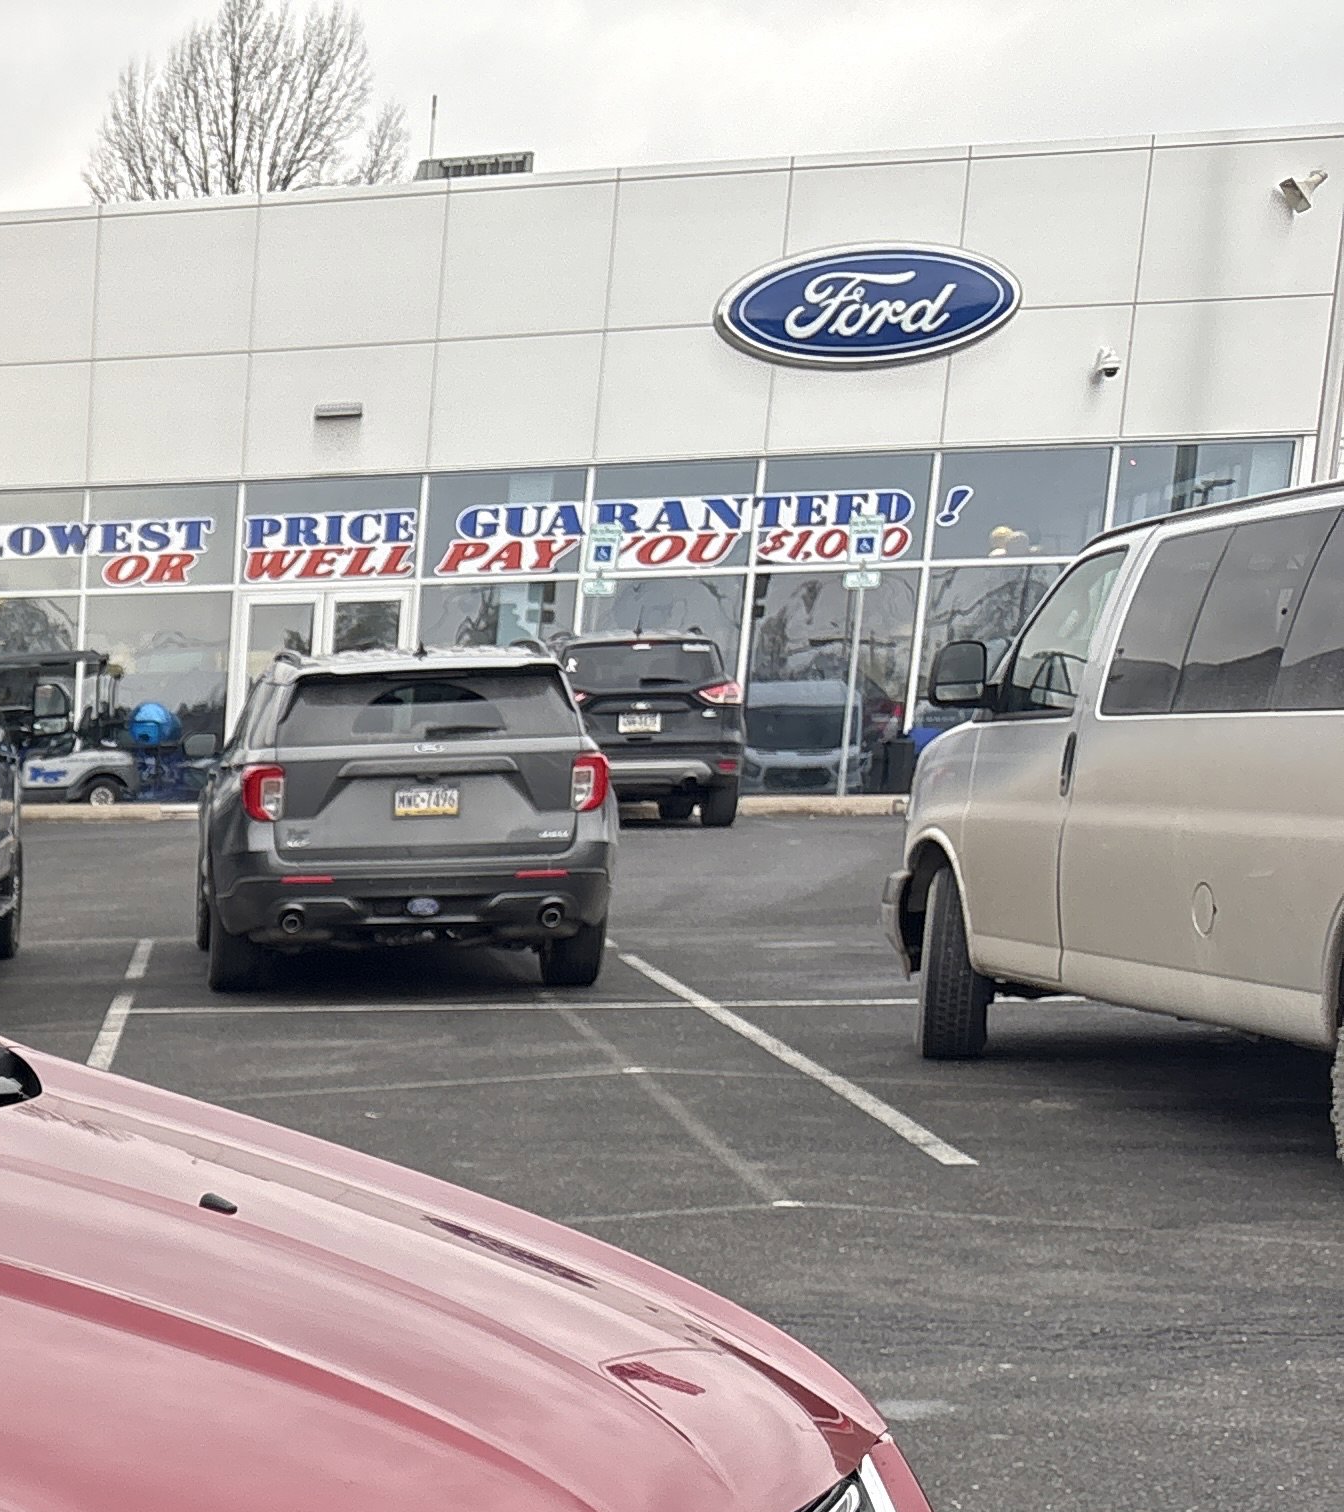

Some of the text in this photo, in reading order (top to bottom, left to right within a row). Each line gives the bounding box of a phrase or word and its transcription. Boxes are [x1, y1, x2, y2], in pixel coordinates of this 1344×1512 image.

[784, 270, 958, 339] Ford
[245, 510, 416, 549] PRICE
[459, 491, 912, 539] GUARANTEED
[103, 553, 196, 585] OR
[437, 538, 580, 573] PAY
[758, 526, 909, 561] $1,00
